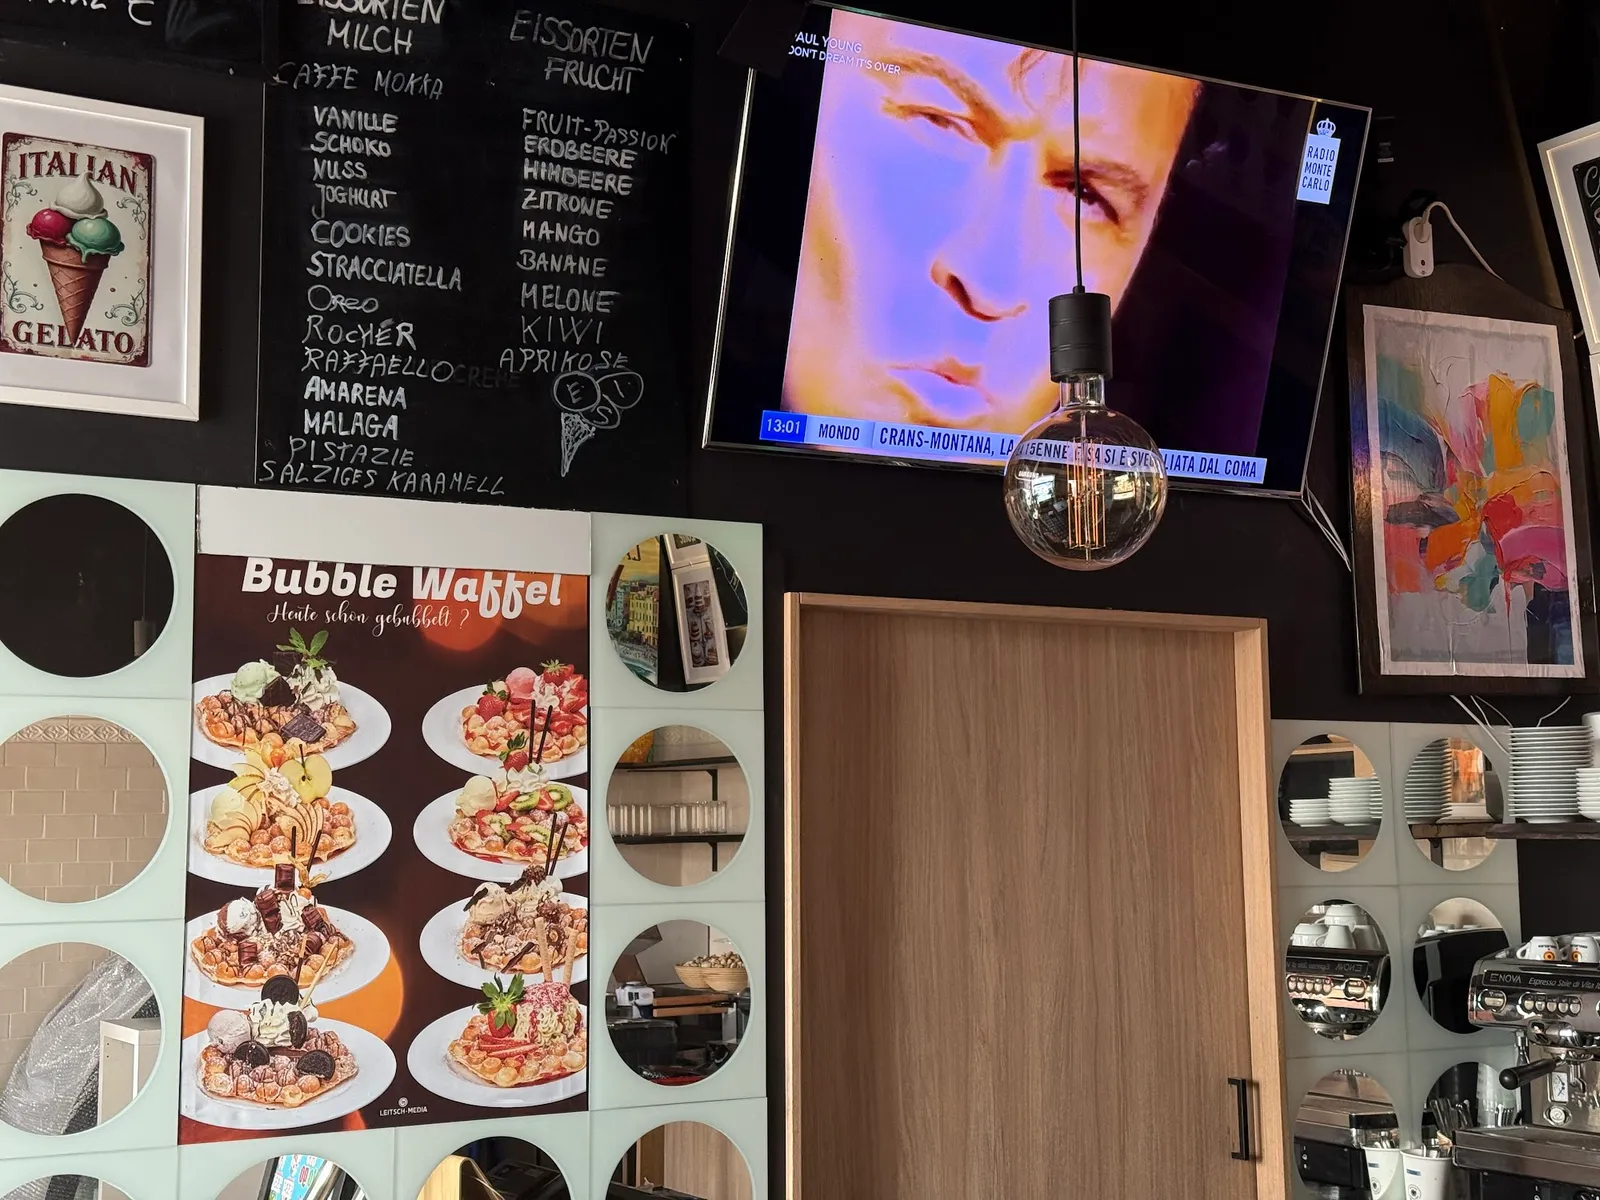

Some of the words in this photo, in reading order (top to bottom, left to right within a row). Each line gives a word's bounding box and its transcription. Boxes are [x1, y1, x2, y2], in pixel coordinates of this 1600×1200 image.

[298, 0, 444, 24] ORTEN
[327, 18, 413, 55] MILCH
[510, 9, 654, 64] EISSORTEN
[794, 31, 820, 46] AUL
[822, 36, 862, 53] YOUNG
[544, 56, 645, 94] FRUCHT
[819, 51, 855, 66] DREAM
[856, 58, 873, 70] IT'S
[874, 61, 901, 75] OVER
[277, 61, 359, 90] CAFFE
[374, 69, 444, 100] MOKKA
[313, 105, 399, 133] VANILLE
[522, 107, 677, 154] FRUIT-PASSION
[310, 131, 392, 158] SCHOKO
[524, 134, 638, 169] ERDBEERE
[1307, 146, 1336, 162] RADIO
[18, 151, 137, 194] ITALIAN
[313, 157, 368, 181] NUSS
[523, 158, 634, 196] HIMBEERE
[1301, 176, 1330, 192] CARLO
[1304, 161, 1333, 177] MONTE
[311, 183, 397, 219] JOGHURT
[521, 188, 614, 219] ZITRONE
[310, 220, 412, 248] COOKIES
[522, 219, 600, 247] MANGO
[306, 250, 462, 292] STRACCIATELLA
[516, 249, 611, 278] BANANE
[521, 282, 622, 314] MELONE
[12, 320, 135, 354] GELATO
[521, 315, 603, 345] KIWI
[301, 346, 454, 383] RAFFAELLO
[499, 347, 629, 373] APRIKOSE
[303, 375, 408, 410] AMARENA
[303, 408, 399, 440] MALAGA
[766, 418, 801, 435] 13:01
[818, 423, 861, 442] MONDO
[289, 435, 415, 468] PISTAZIE
[879, 427, 996, 457] CRANS-MONTANA,
[1104, 448, 1116, 465] SI
[1130, 451, 1195, 473] SVELIATA
[1199, 457, 1220, 475] DAL
[1224, 459, 1257, 478] COMA
[258, 460, 378, 489] SALZIGES
[386, 471, 506, 496] KARAMELL
[241, 556, 398, 599] Bubble
[412, 566, 561, 620] Waffel
[266, 601, 319, 624] Heute
[372, 603, 452, 638] gebubbelt
[459, 608, 470, 630] ?
